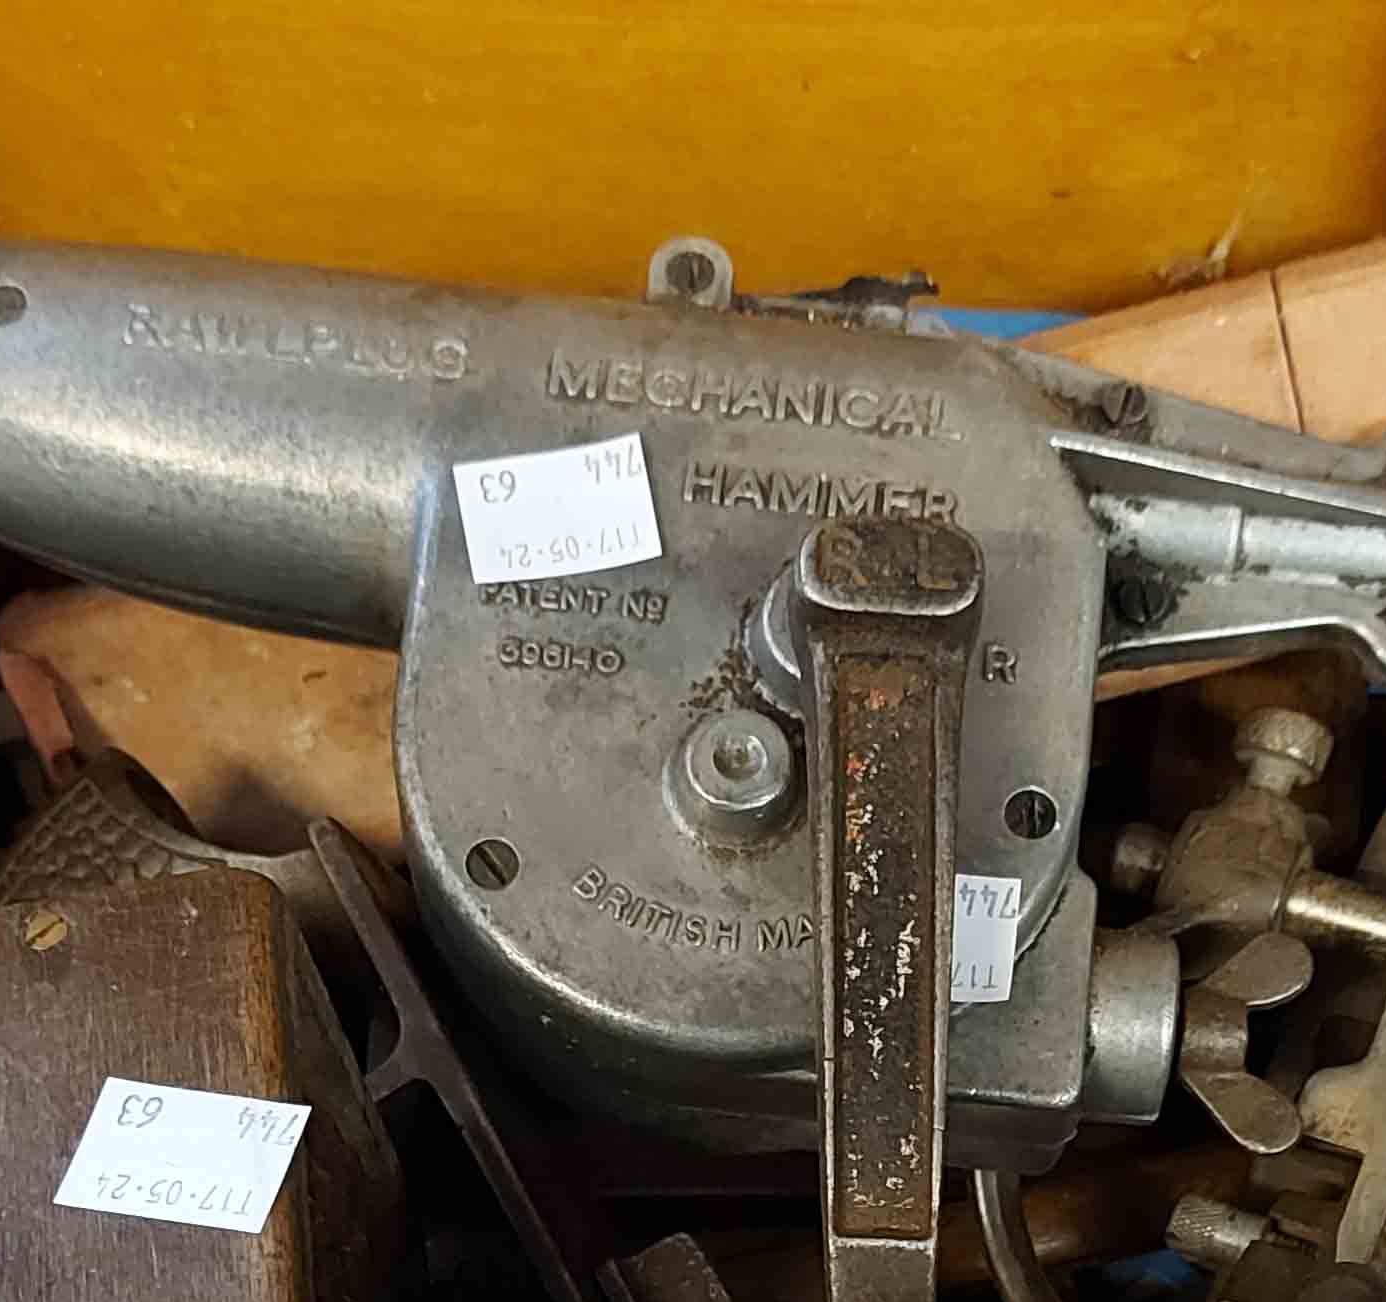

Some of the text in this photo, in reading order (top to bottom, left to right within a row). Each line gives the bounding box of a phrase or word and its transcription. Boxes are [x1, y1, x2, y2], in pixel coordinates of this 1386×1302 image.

[545, 347, 966, 442] MECHANICAL
[480, 469, 517, 504] 63
[682, 460, 961, 525] HAMMER
[571, 866, 741, 951] BRITISH
[959, 882, 1017, 919] 744
[117, 1094, 300, 1146] 744 63
